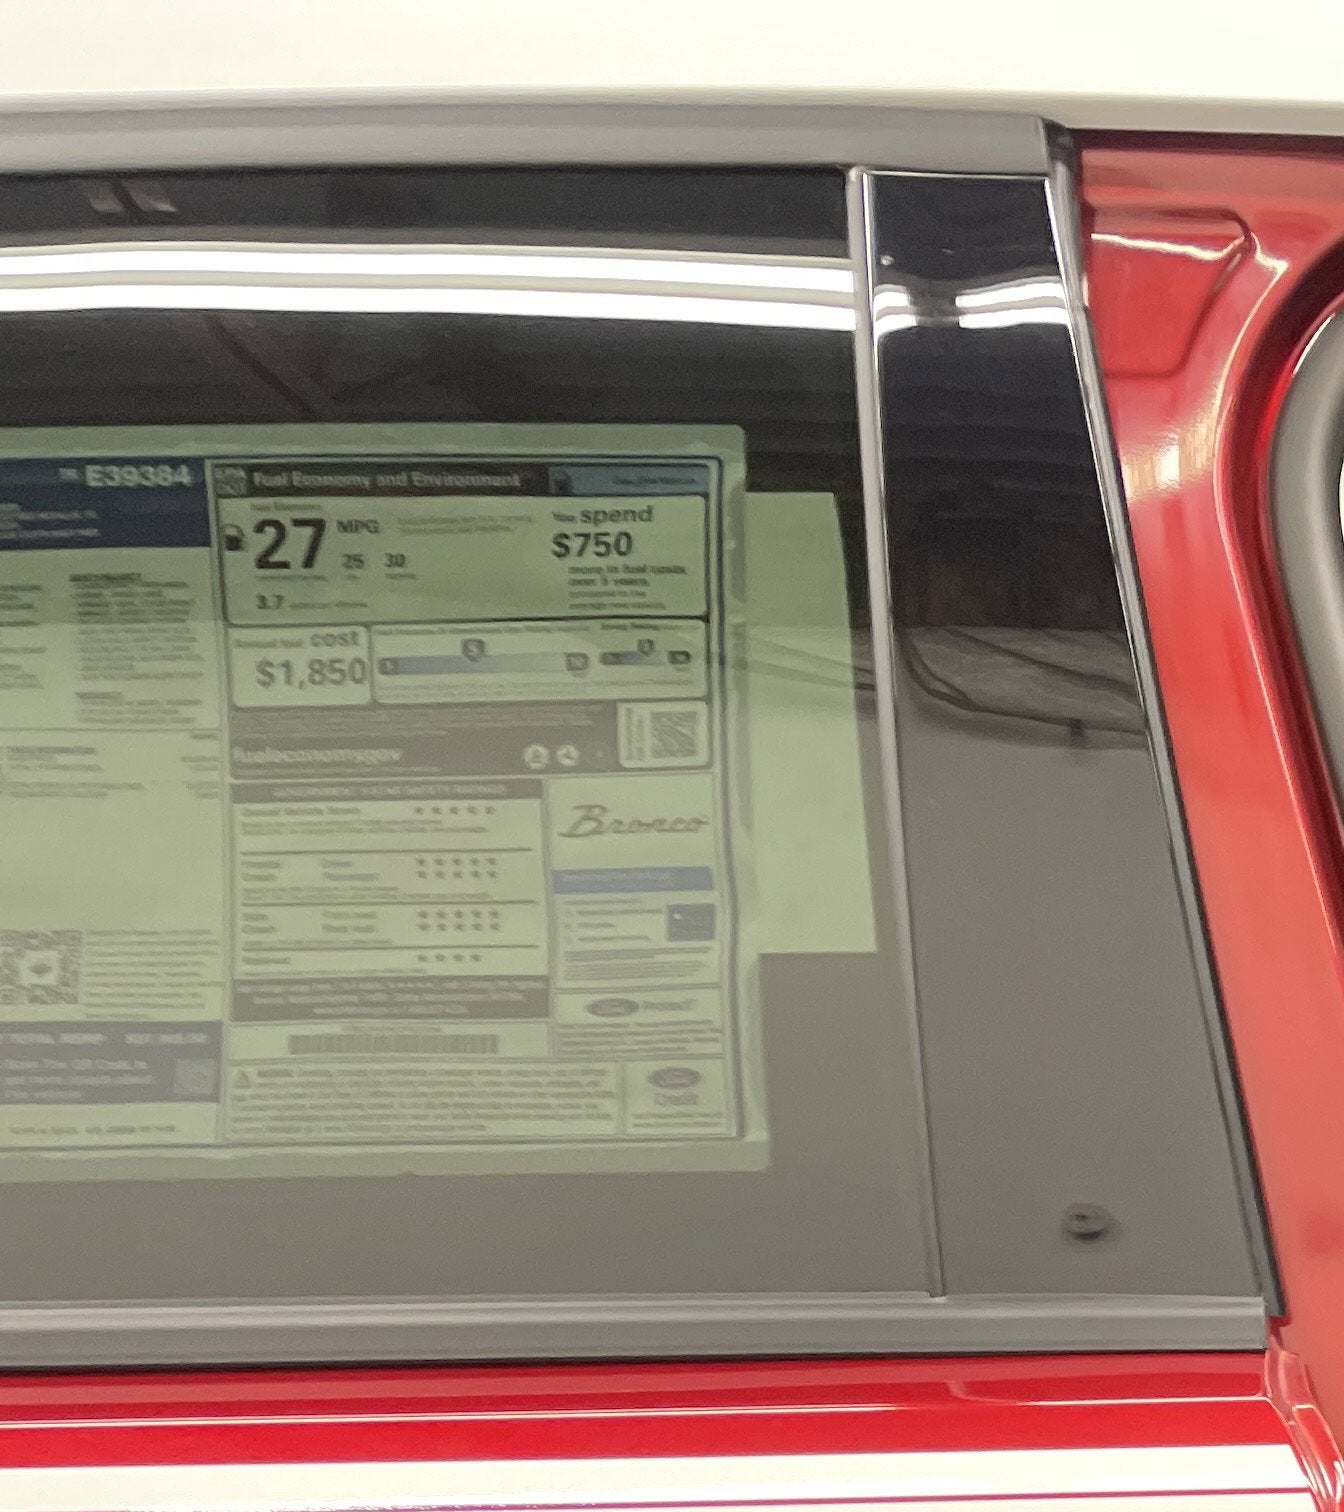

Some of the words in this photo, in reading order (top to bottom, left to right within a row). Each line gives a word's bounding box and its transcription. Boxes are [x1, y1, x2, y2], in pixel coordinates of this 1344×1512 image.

[85, 464, 192, 487] E39384
[336, 519, 380, 534] MPG
[580, 504, 654, 527] spend
[253, 518, 327, 569] 27
[551, 530, 633, 559] $750
[310, 631, 360, 648] cost
[255, 656, 368, 690] $1,850
[557, 804, 710, 838] Bronco
